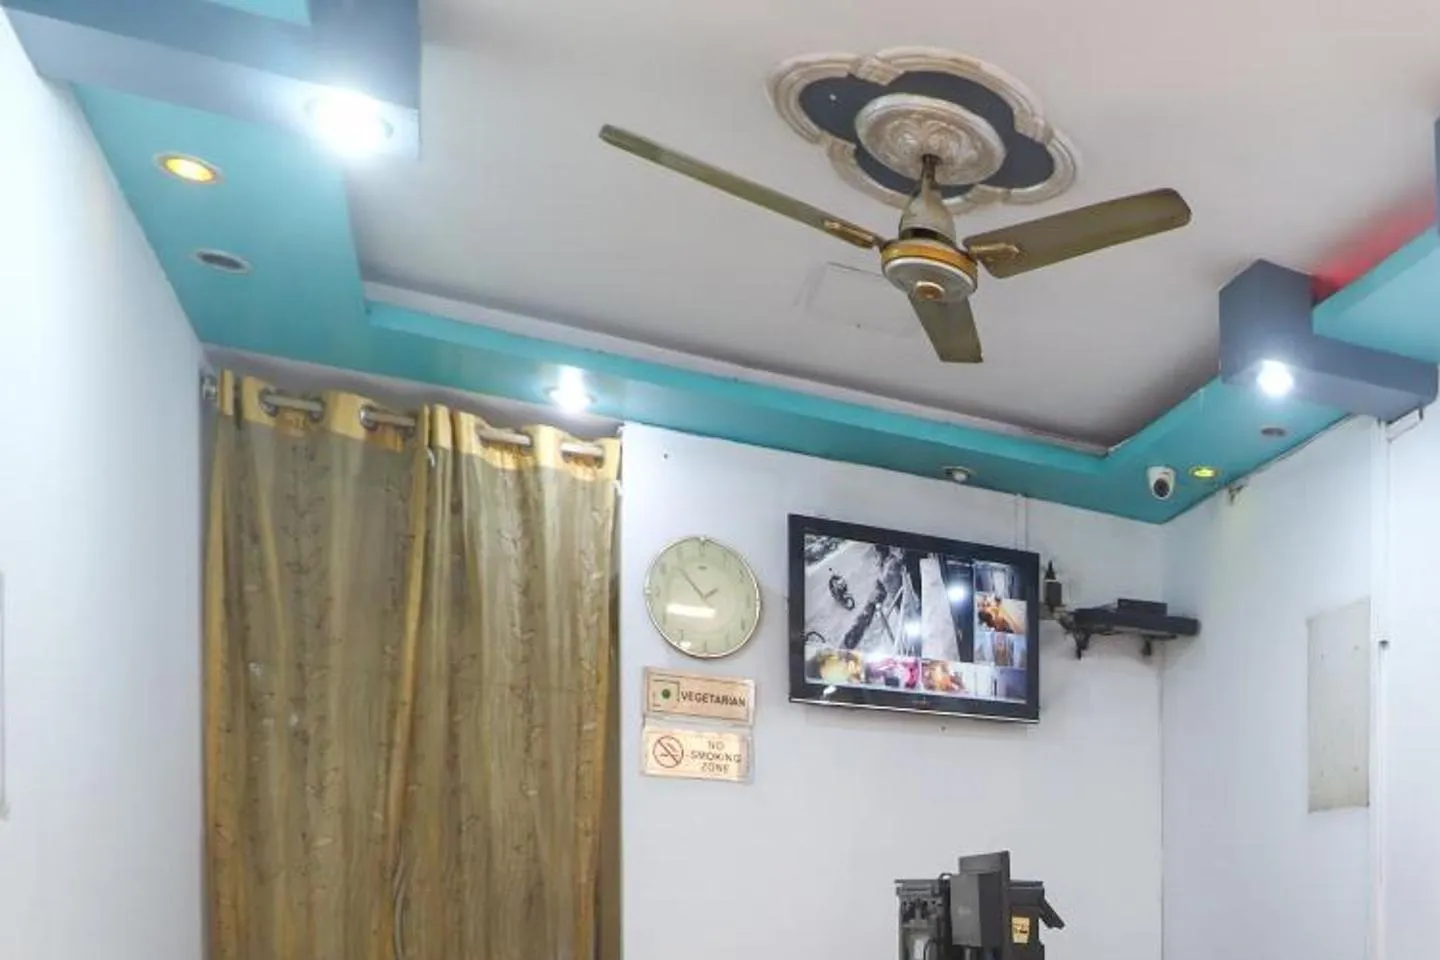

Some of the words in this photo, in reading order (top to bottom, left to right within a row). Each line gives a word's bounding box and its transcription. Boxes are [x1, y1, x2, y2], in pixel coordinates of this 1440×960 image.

[681, 691, 746, 707] VEGETARIAN
[707, 740, 725, 751] NO
[690, 750, 742, 764] SMOKING
[701, 762, 730, 774] ZONE
